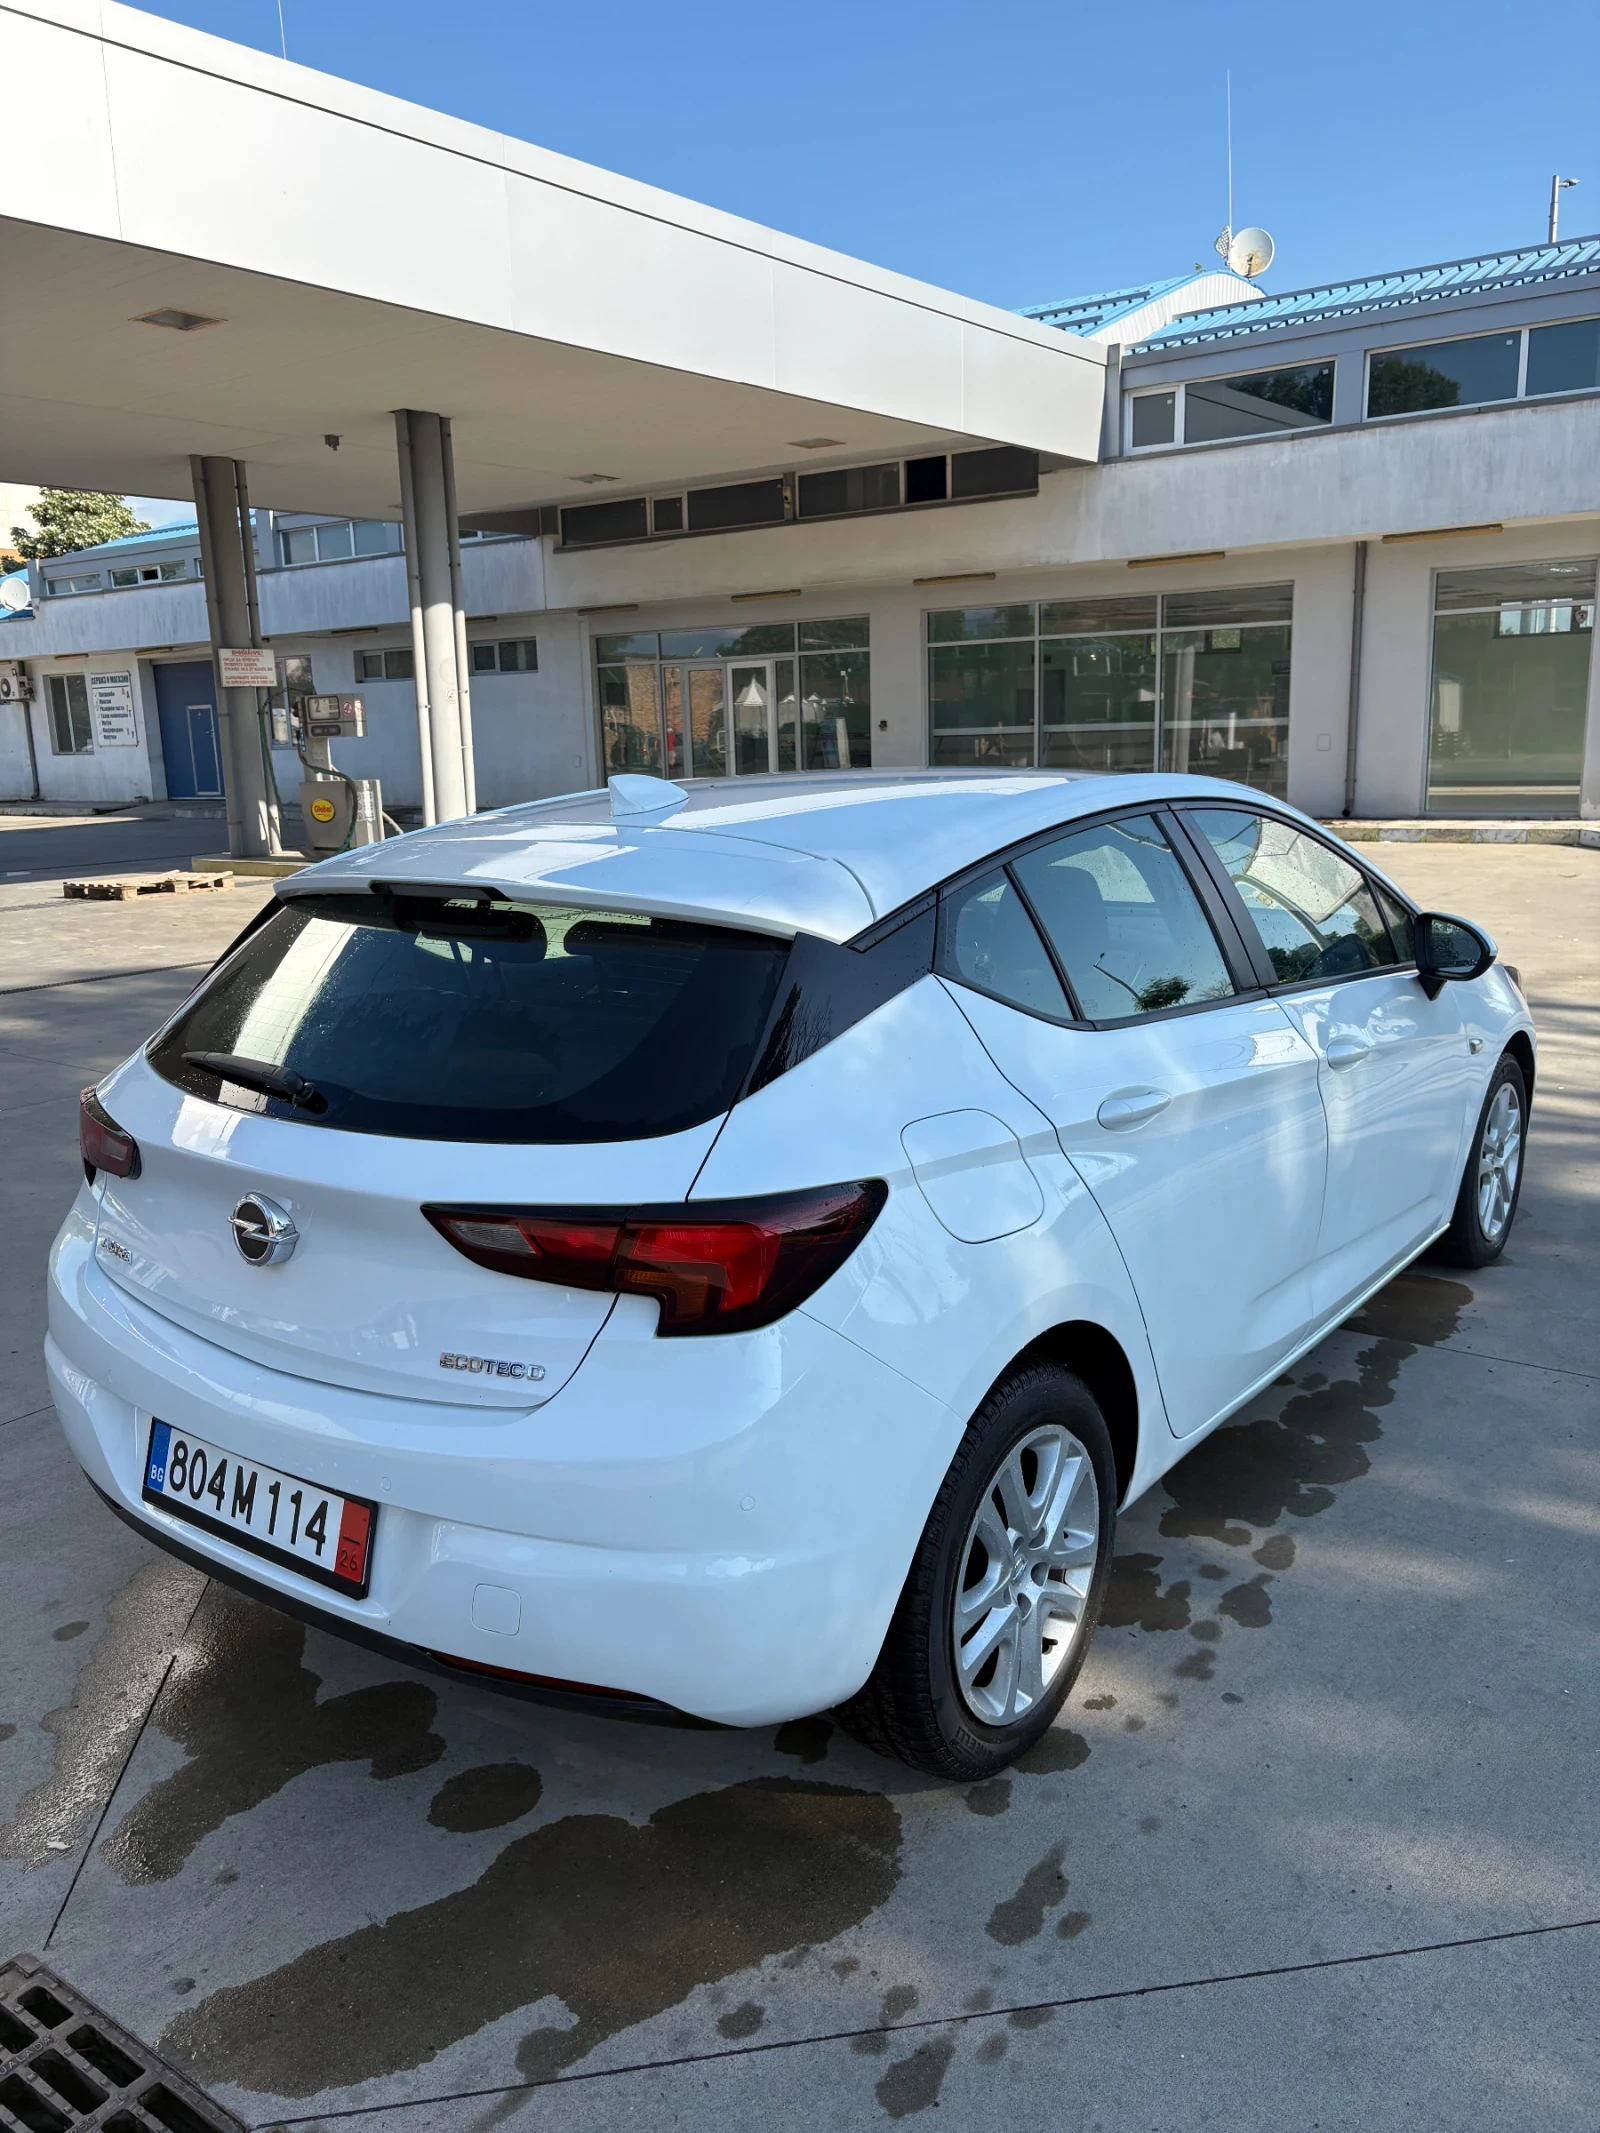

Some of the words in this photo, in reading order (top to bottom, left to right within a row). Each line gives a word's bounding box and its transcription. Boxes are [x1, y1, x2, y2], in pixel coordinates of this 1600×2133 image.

[315, 698, 321, 713] 2
[150, 1464, 164, 1483] BG
[339, 1550, 358, 1571] 26
